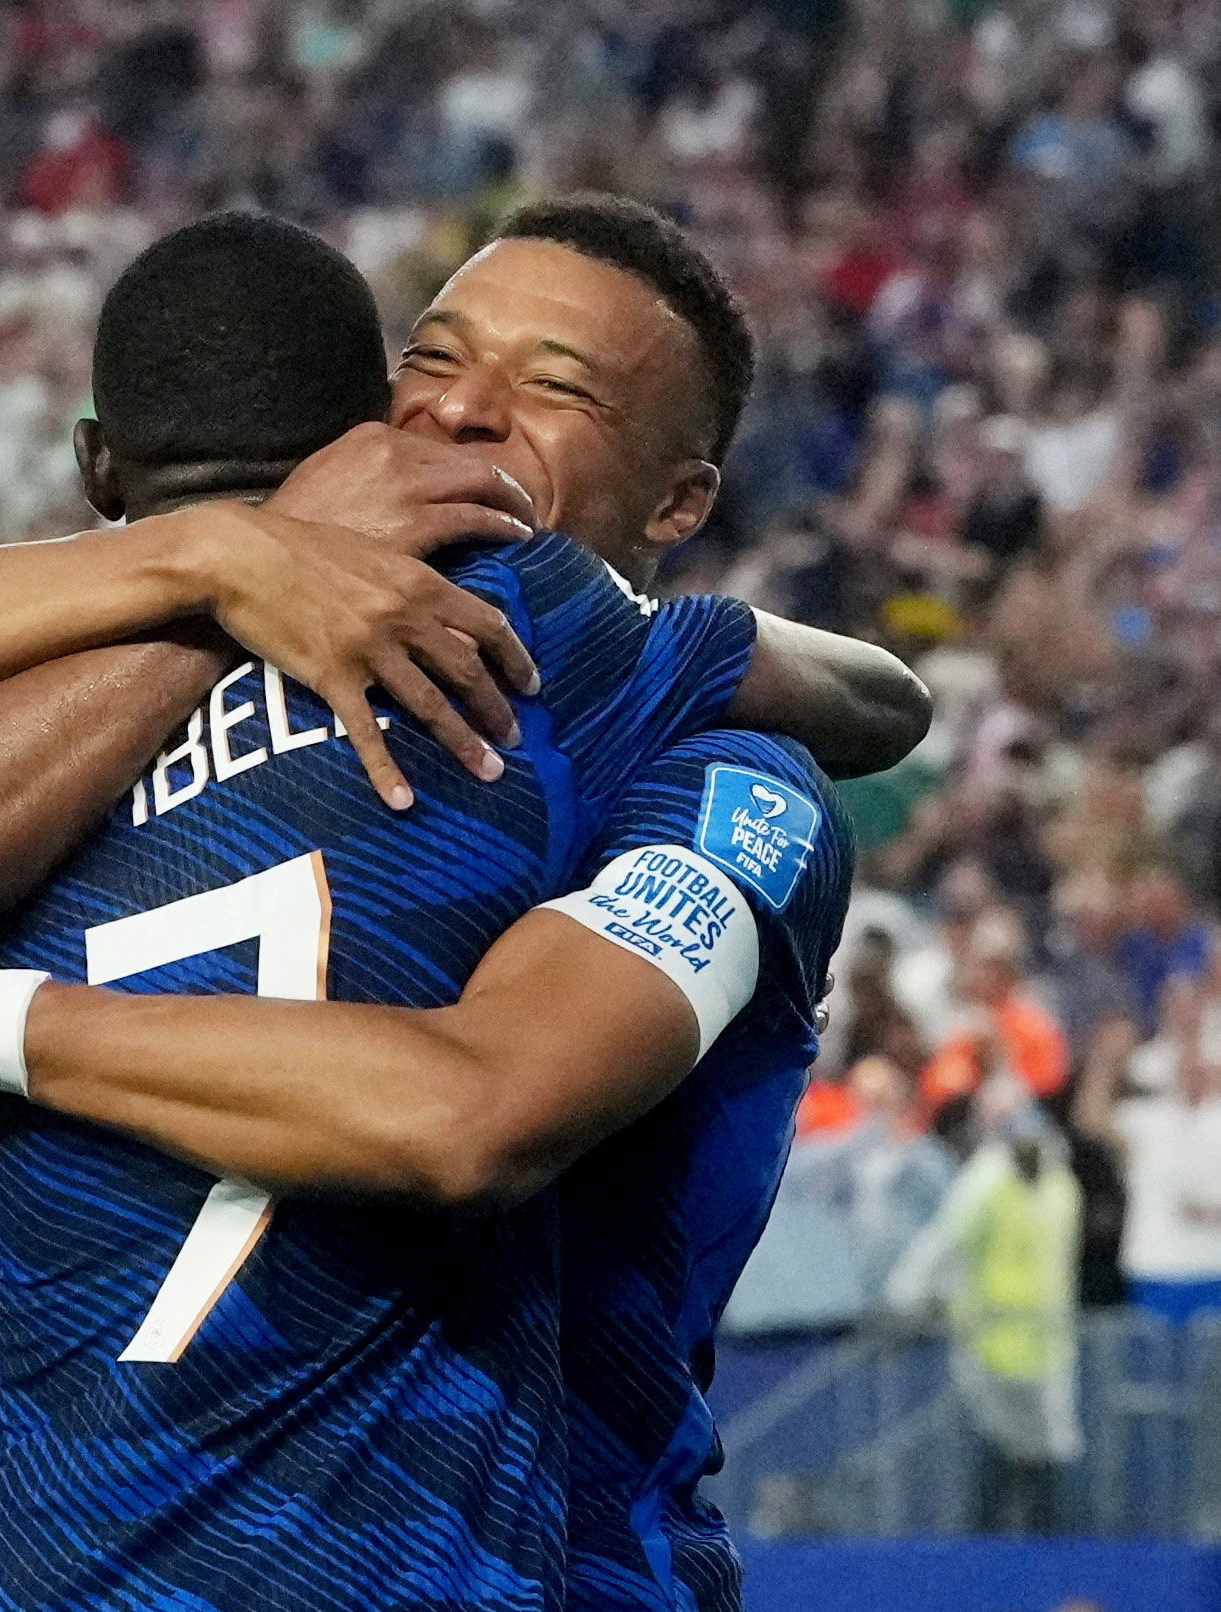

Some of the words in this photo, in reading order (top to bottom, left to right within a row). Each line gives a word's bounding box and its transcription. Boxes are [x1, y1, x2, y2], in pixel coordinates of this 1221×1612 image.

[731, 806, 771, 836] Unite
[731, 826, 782, 873] PEACE
[633, 850, 736, 930] FOOTBALL
[736, 851, 763, 878] FIFA
[588, 895, 631, 918] the
[632, 910, 711, 974] World
[614, 871, 722, 950] UNITES
[85, 849, 332, 1362] 7
